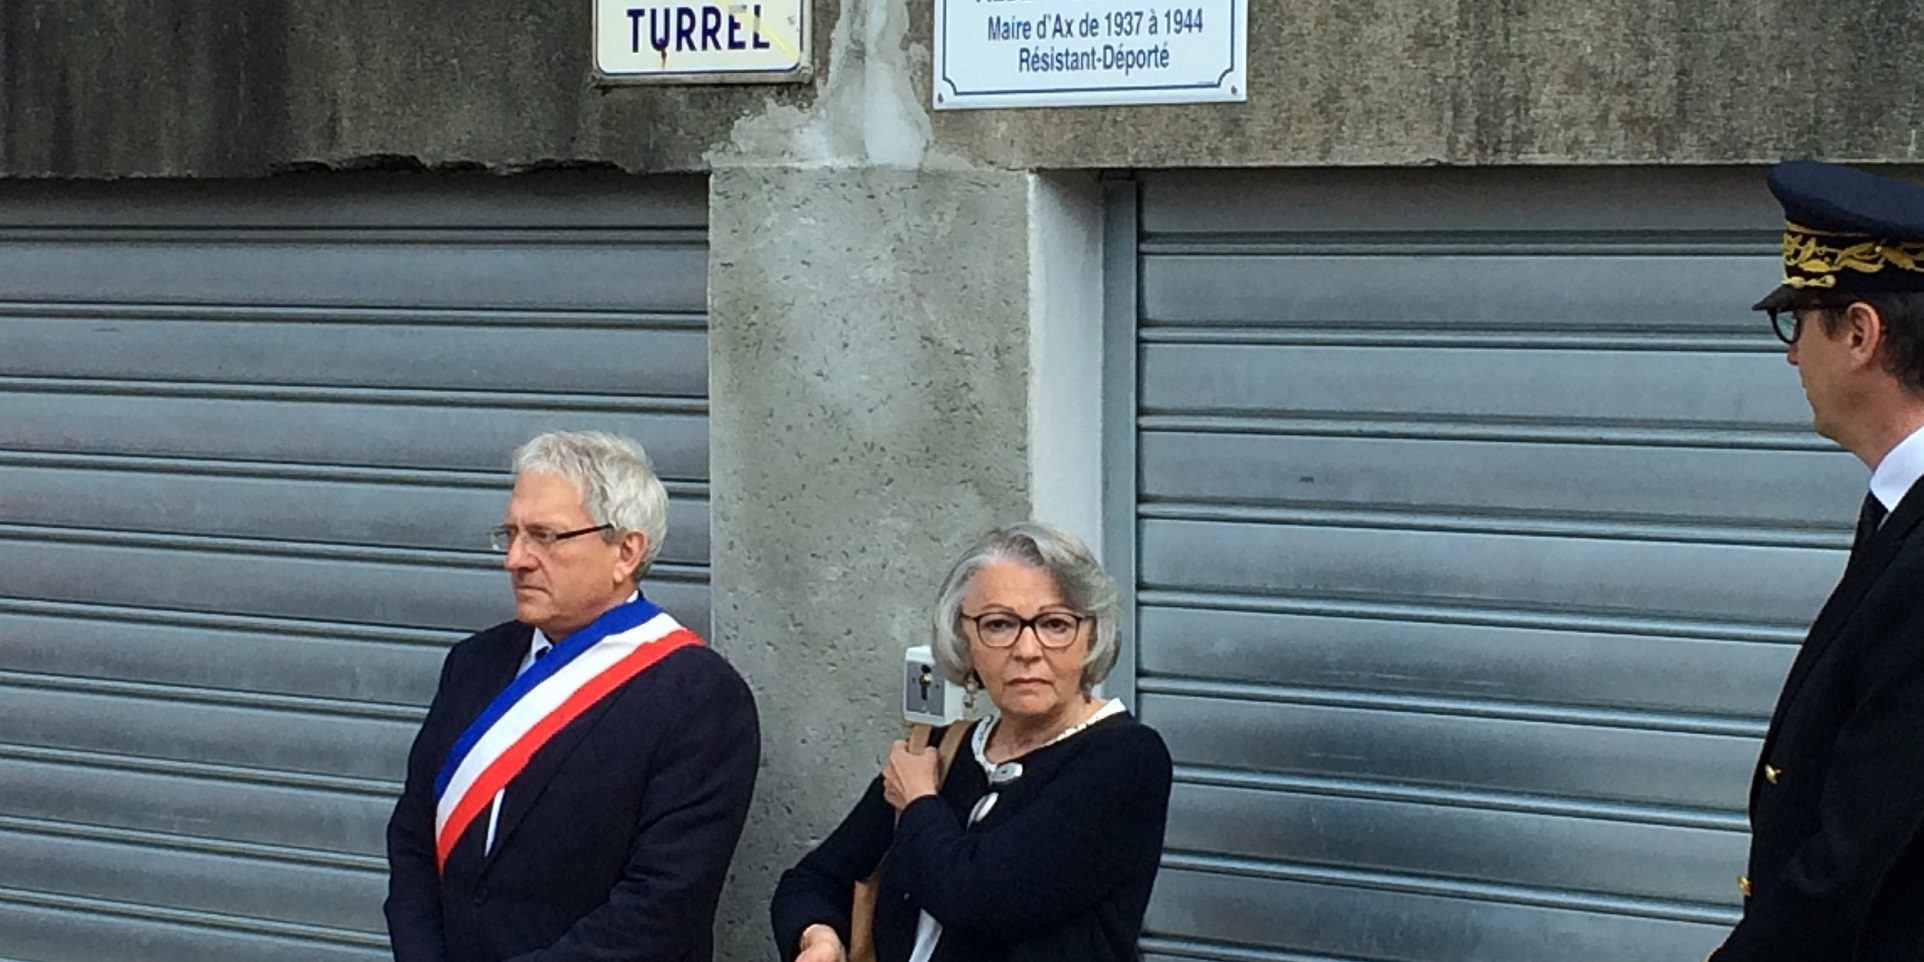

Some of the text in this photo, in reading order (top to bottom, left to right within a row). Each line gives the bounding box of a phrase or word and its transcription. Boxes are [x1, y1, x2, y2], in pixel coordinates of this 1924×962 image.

[627, 4, 770, 53] TURREL
[987, 8, 1203, 41] Maire d'Ax de 1937 à 1944
[1018, 41, 1170, 75] Résistant-Déporté
